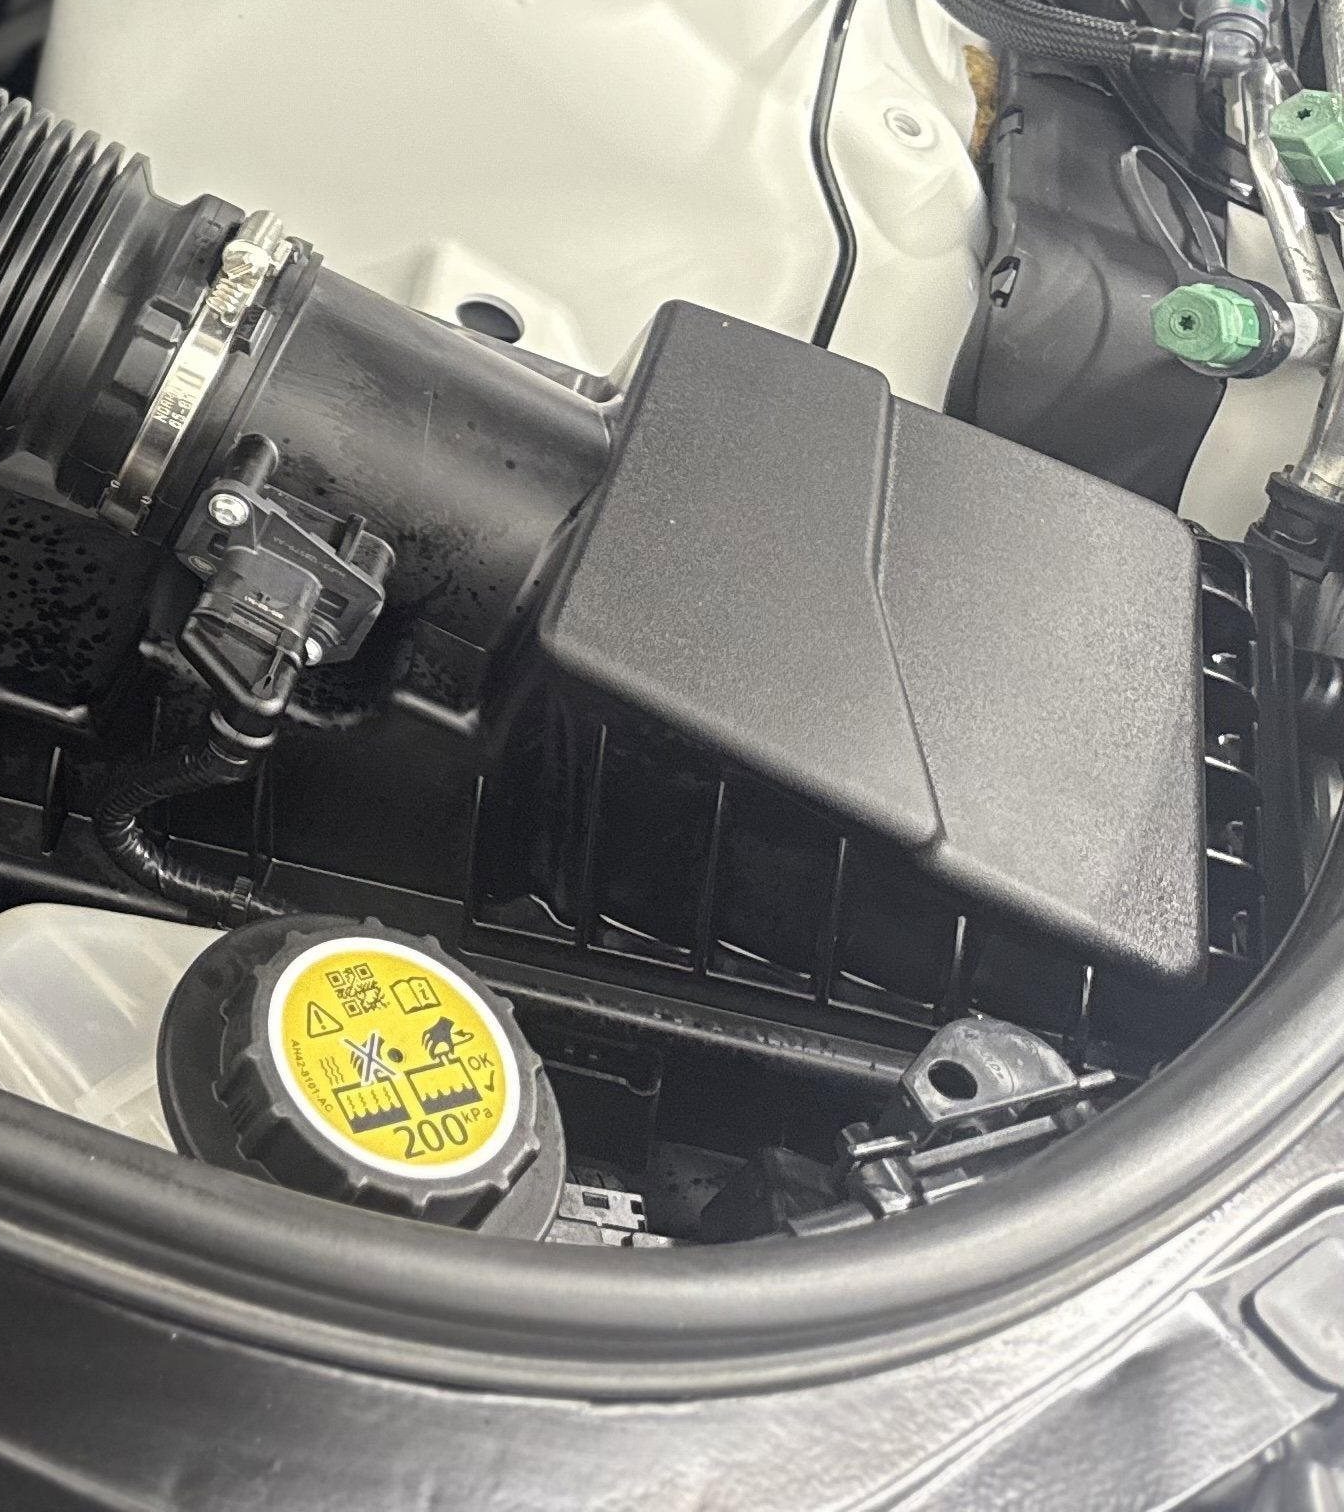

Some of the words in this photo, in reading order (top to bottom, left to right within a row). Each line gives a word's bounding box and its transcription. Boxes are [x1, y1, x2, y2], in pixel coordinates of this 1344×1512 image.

[467, 1052, 496, 1072] OK
[392, 1113, 469, 1160] 200
[463, 1106, 494, 1125] kPa
